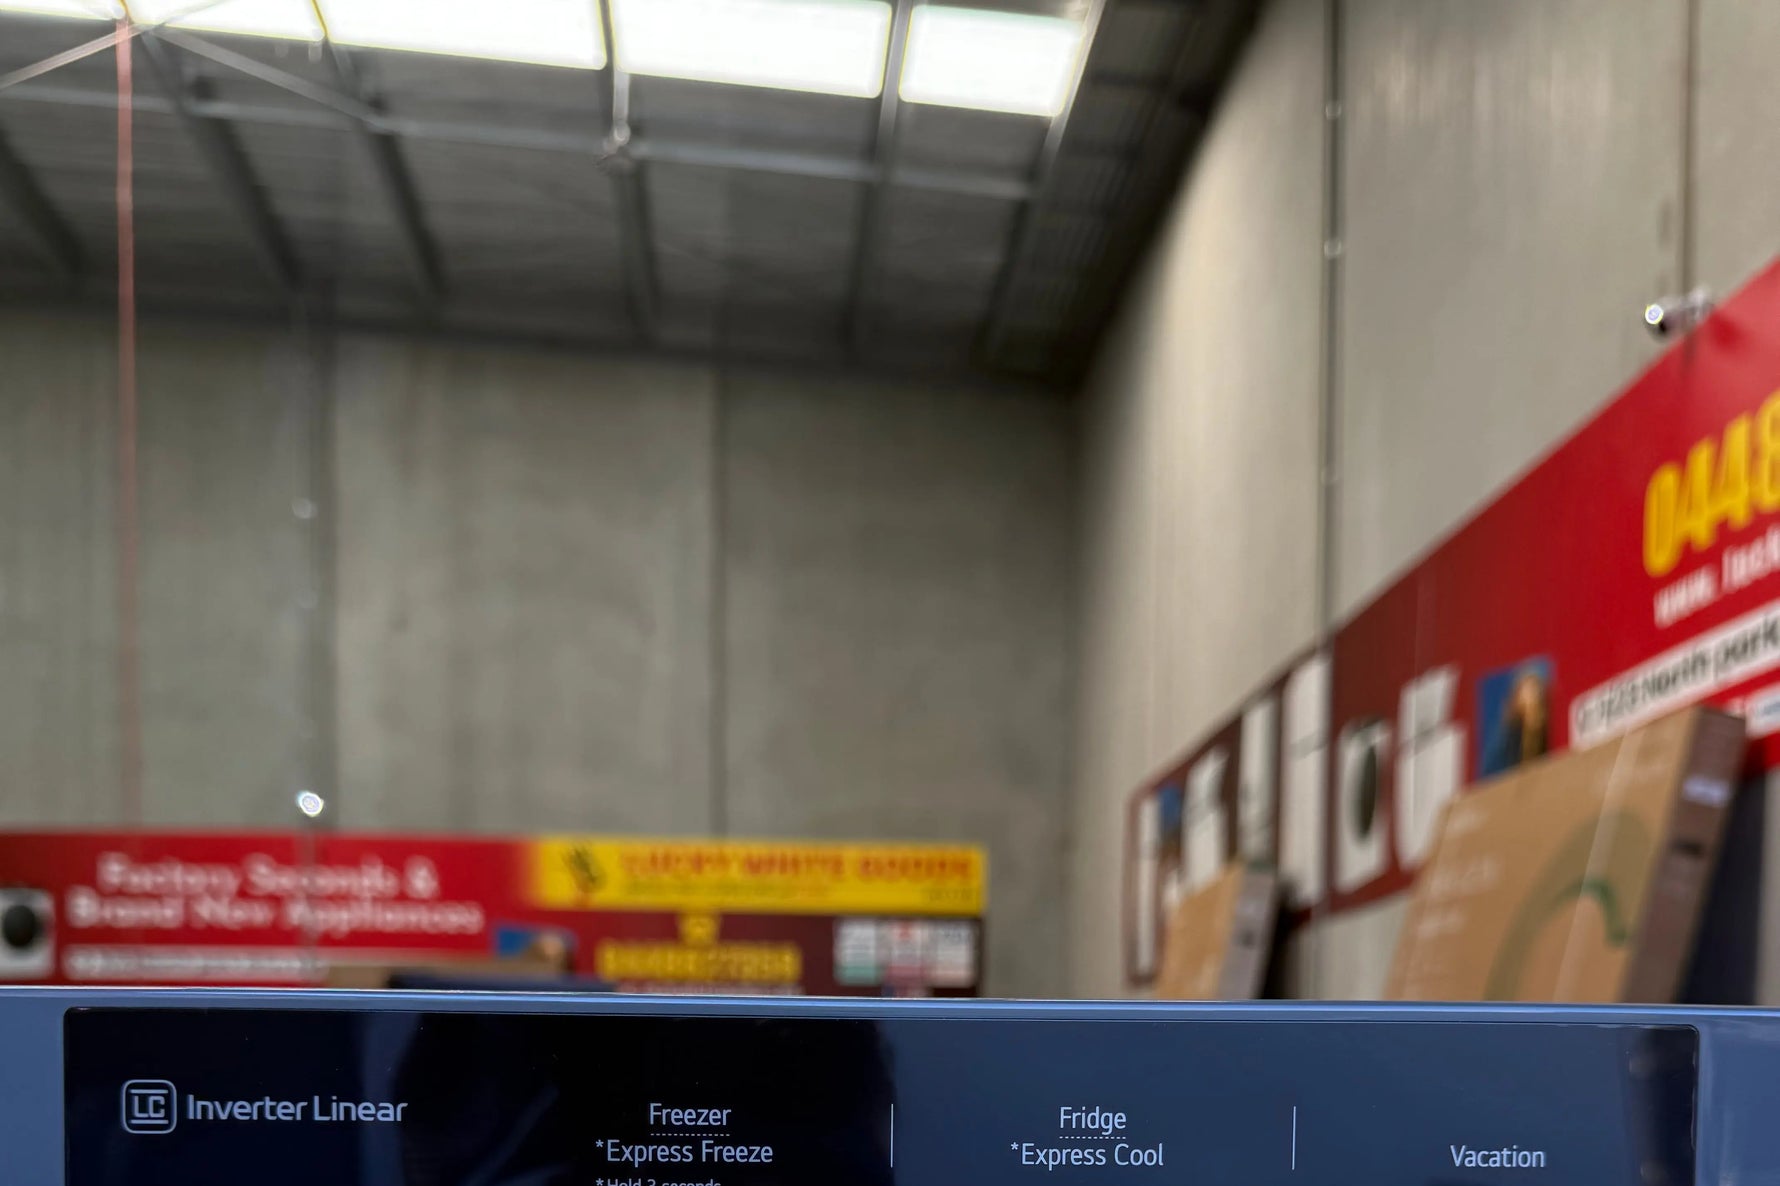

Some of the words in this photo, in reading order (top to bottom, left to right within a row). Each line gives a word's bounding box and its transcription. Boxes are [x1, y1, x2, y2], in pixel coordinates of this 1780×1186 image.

[187, 1095, 308, 1121] Inverter
[314, 1096, 409, 1122] Linear
[649, 1102, 732, 1126] Freezer
[1058, 1106, 1127, 1133] Fridge
[702, 1139, 774, 1163] Freeze
[1114, 1143, 1164, 1166] Cool
[1450, 1145, 1546, 1168] Vacation
